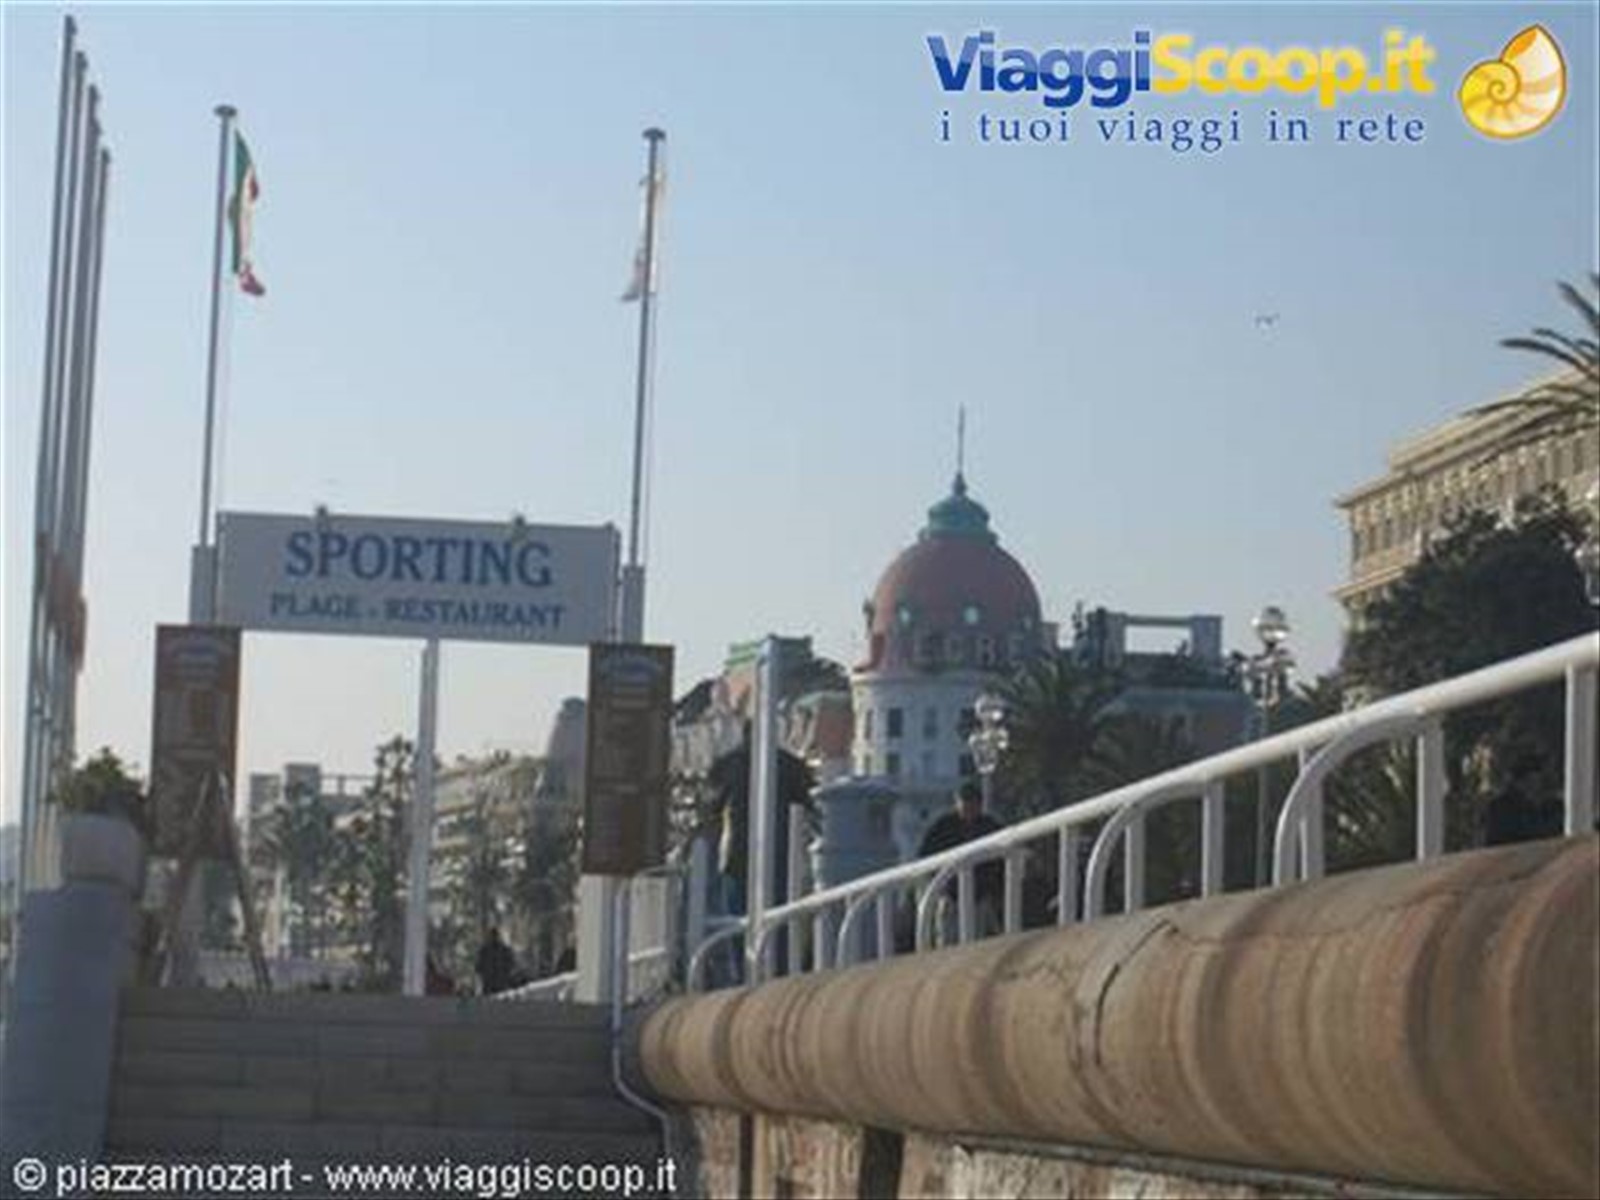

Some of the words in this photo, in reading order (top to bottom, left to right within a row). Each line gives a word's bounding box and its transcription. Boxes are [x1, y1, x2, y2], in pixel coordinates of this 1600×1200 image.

[285, 530, 553, 587] SPORTING
[270, 593, 358, 618] PLAGE
[385, 597, 566, 628] RESTAURANT
